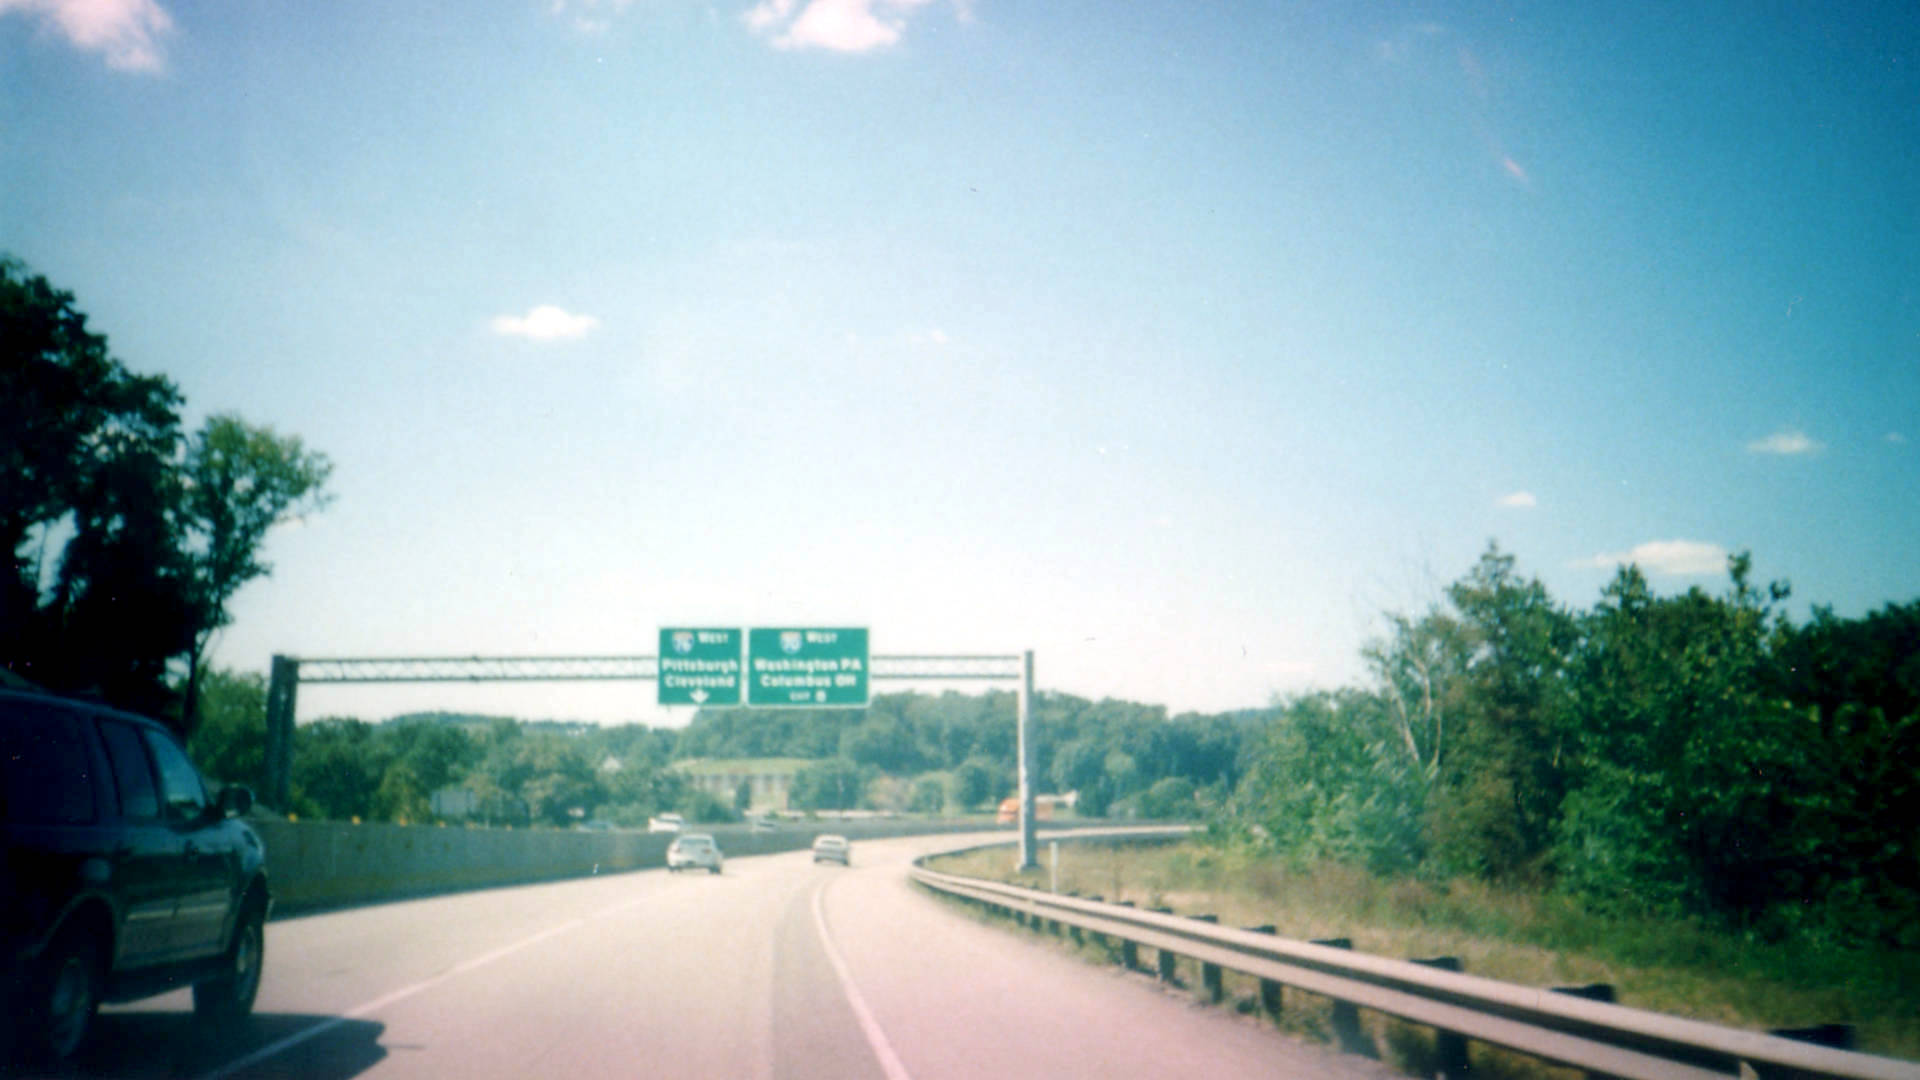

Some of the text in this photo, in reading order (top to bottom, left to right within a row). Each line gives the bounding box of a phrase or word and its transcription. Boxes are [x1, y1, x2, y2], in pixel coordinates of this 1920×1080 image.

[698, 631, 728, 643] WEST
[806, 632, 837, 643] WEST
[662, 658, 738, 674] Pittsburgh
[754, 658, 862, 673] Washington PA
[665, 674, 735, 688] Cleveland
[760, 674, 857, 687] Columbus OH
